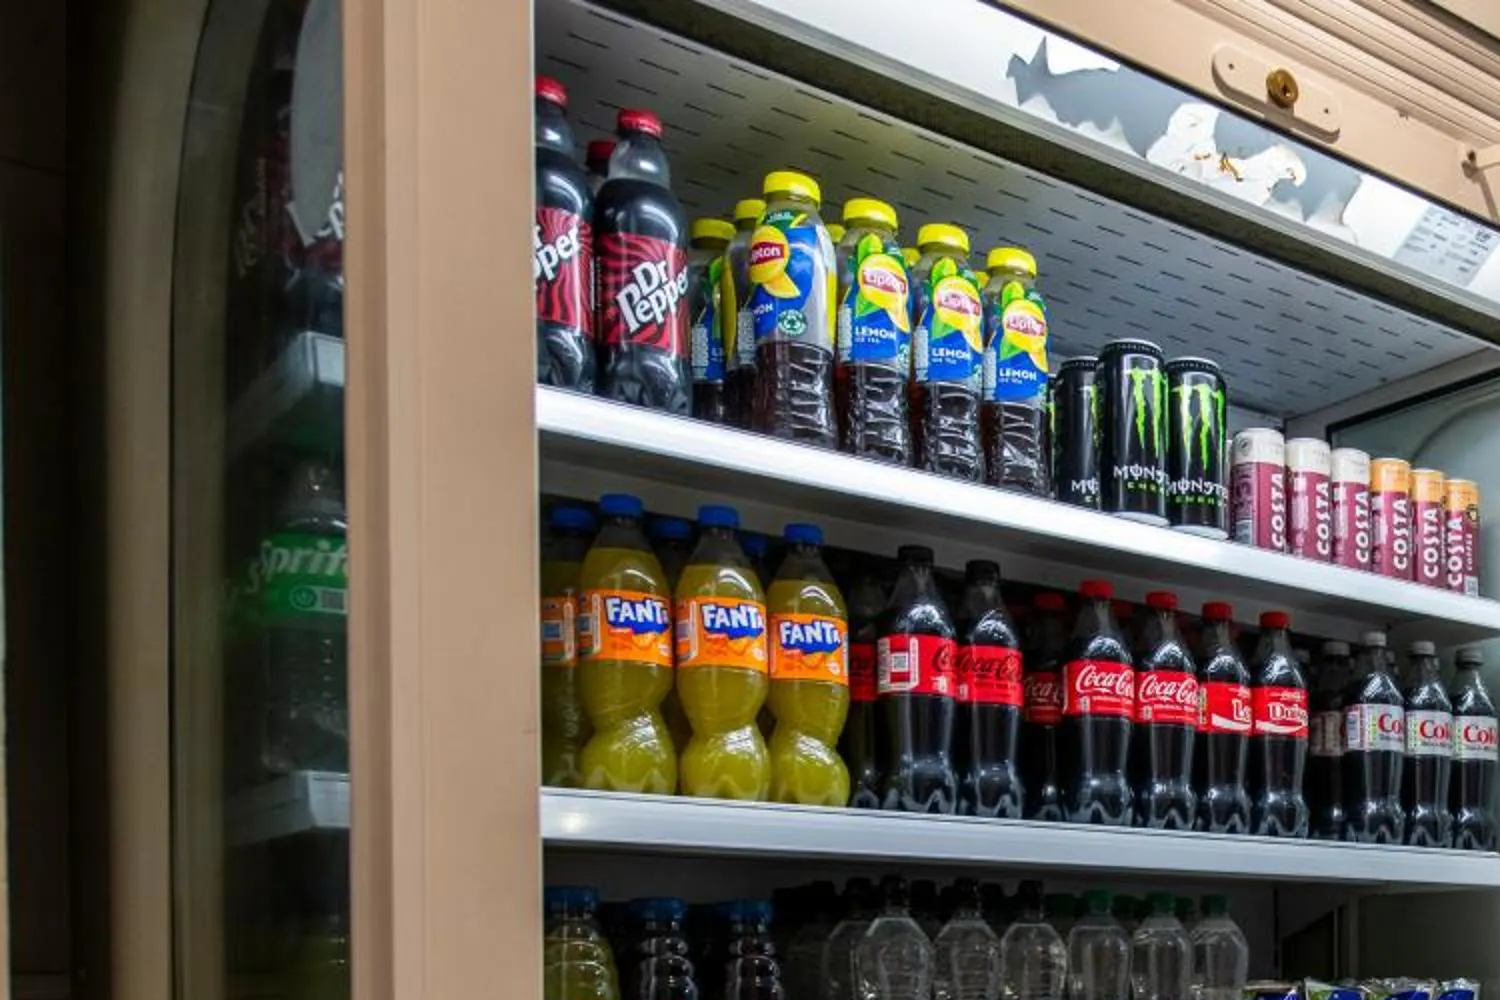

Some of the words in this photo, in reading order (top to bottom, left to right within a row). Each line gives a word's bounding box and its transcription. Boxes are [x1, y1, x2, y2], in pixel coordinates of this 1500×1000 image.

[534, 226, 579, 282] pper
[631, 260, 668, 296] Dr
[864, 273, 906, 292] Lipton
[855, 326, 897, 340] LEMON
[931, 348, 971, 361] LEMON
[999, 368, 1037, 381] LEMON
[1113, 464, 1169, 487] MONST
[1170, 477, 1229, 500] MONSTE
[1271, 473, 1285, 548] COSTA
[1316, 482, 1330, 555] COSTA
[1355, 492, 1370, 563] COSTA
[1393, 499, 1408, 570] COSTA
[1423, 508, 1440, 579] COSTA
[1447, 517, 1465, 587] COSTA
[260, 539, 346, 583] Sprit
[701, 603, 765, 630] FANTA
[779, 622, 842, 645] FANTA
[1075, 665, 1134, 698] Coca-Co
[1378, 713, 1400, 733] Co
[1420, 719, 1448, 738] Cok
[1463, 724, 1497, 744] Cok
